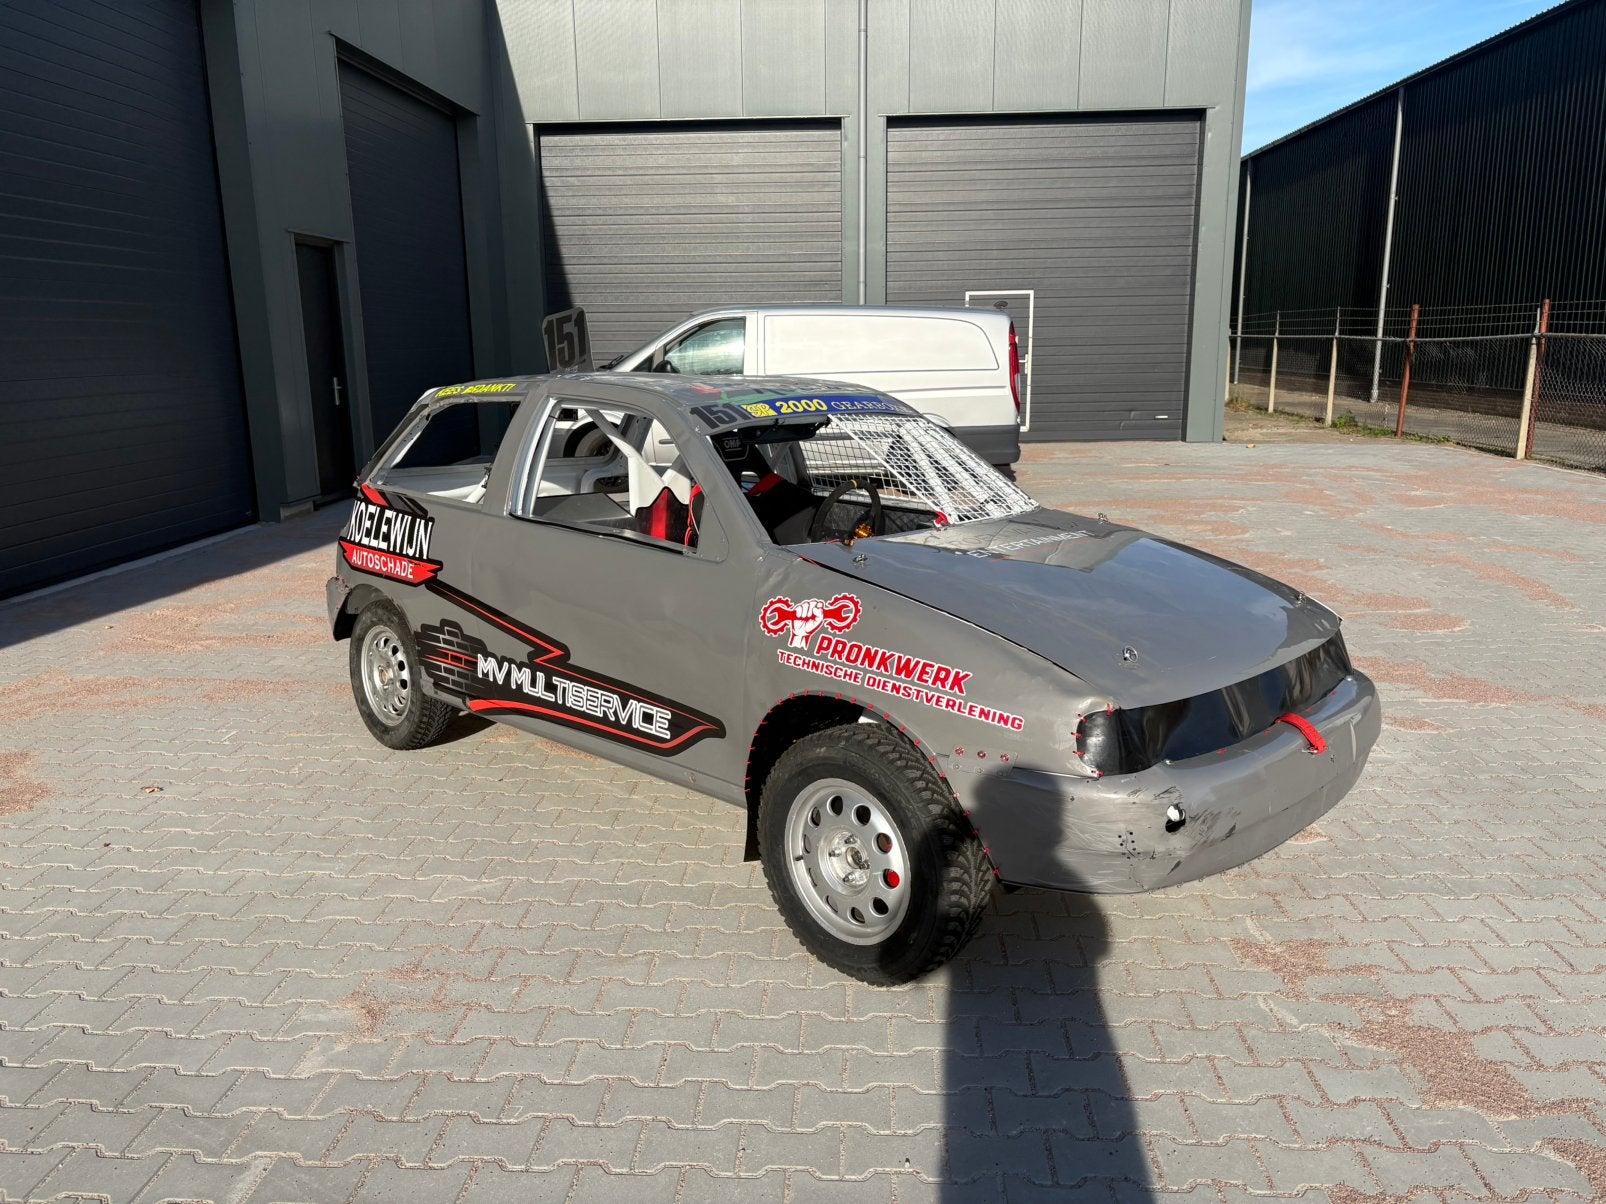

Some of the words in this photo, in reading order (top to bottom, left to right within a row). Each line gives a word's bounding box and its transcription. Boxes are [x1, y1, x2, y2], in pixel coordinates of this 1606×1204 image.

[544, 310, 586, 371] 151
[690, 403, 753, 430] 151
[775, 399, 828, 414] 2000
[347, 500, 432, 560] KOELEWIJN
[967, 530, 1095, 559] ENTERTAINMENT
[351, 548, 415, 579] AUTOSCHADE
[777, 649, 863, 686] TECHNISCHE
[864, 674, 1025, 732] DIENSTVERLENING
[814, 634, 973, 696] PRONKWERK
[477, 653, 508, 685] MV
[510, 663, 672, 740] MULTISERVICE
